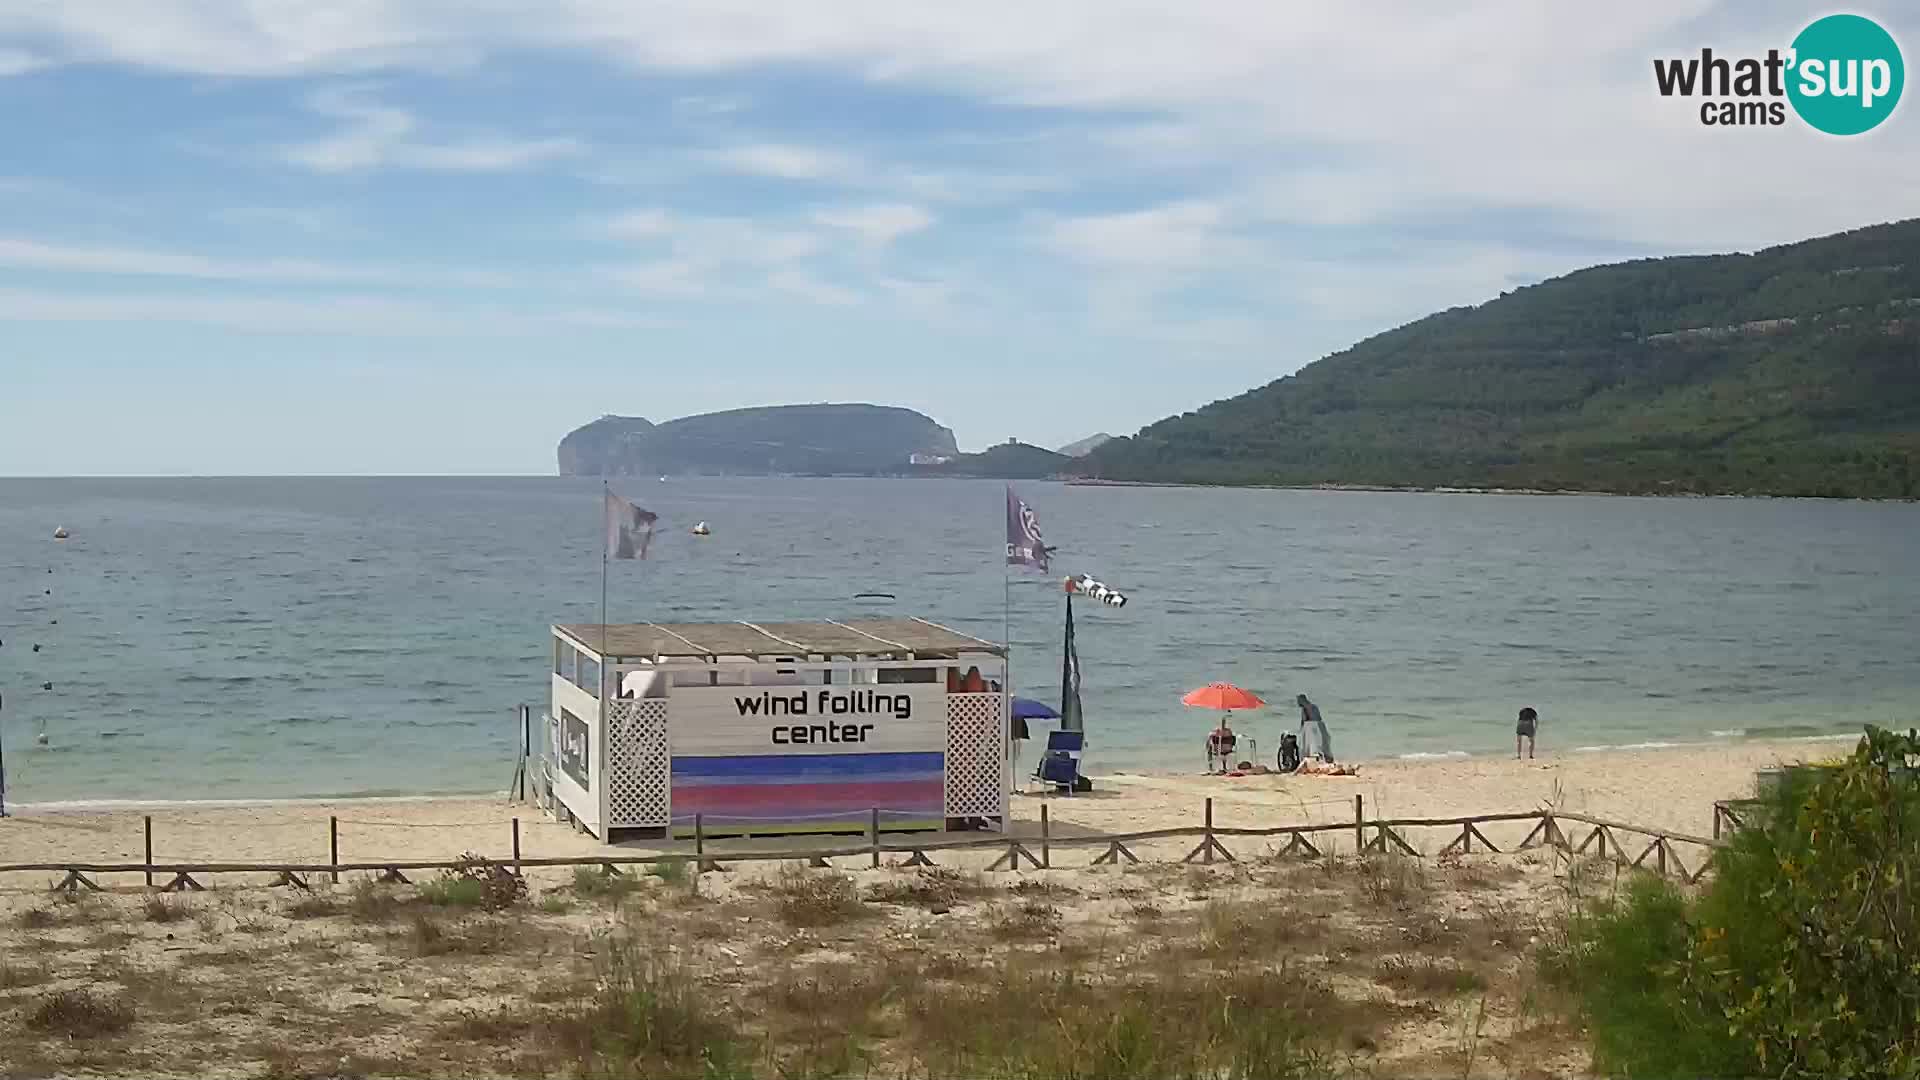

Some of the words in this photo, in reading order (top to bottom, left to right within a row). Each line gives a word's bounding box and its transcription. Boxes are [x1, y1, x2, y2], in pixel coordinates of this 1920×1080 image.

[735, 691, 808, 715] wind
[818, 690, 911, 719] foiling
[772, 720, 874, 744] center
